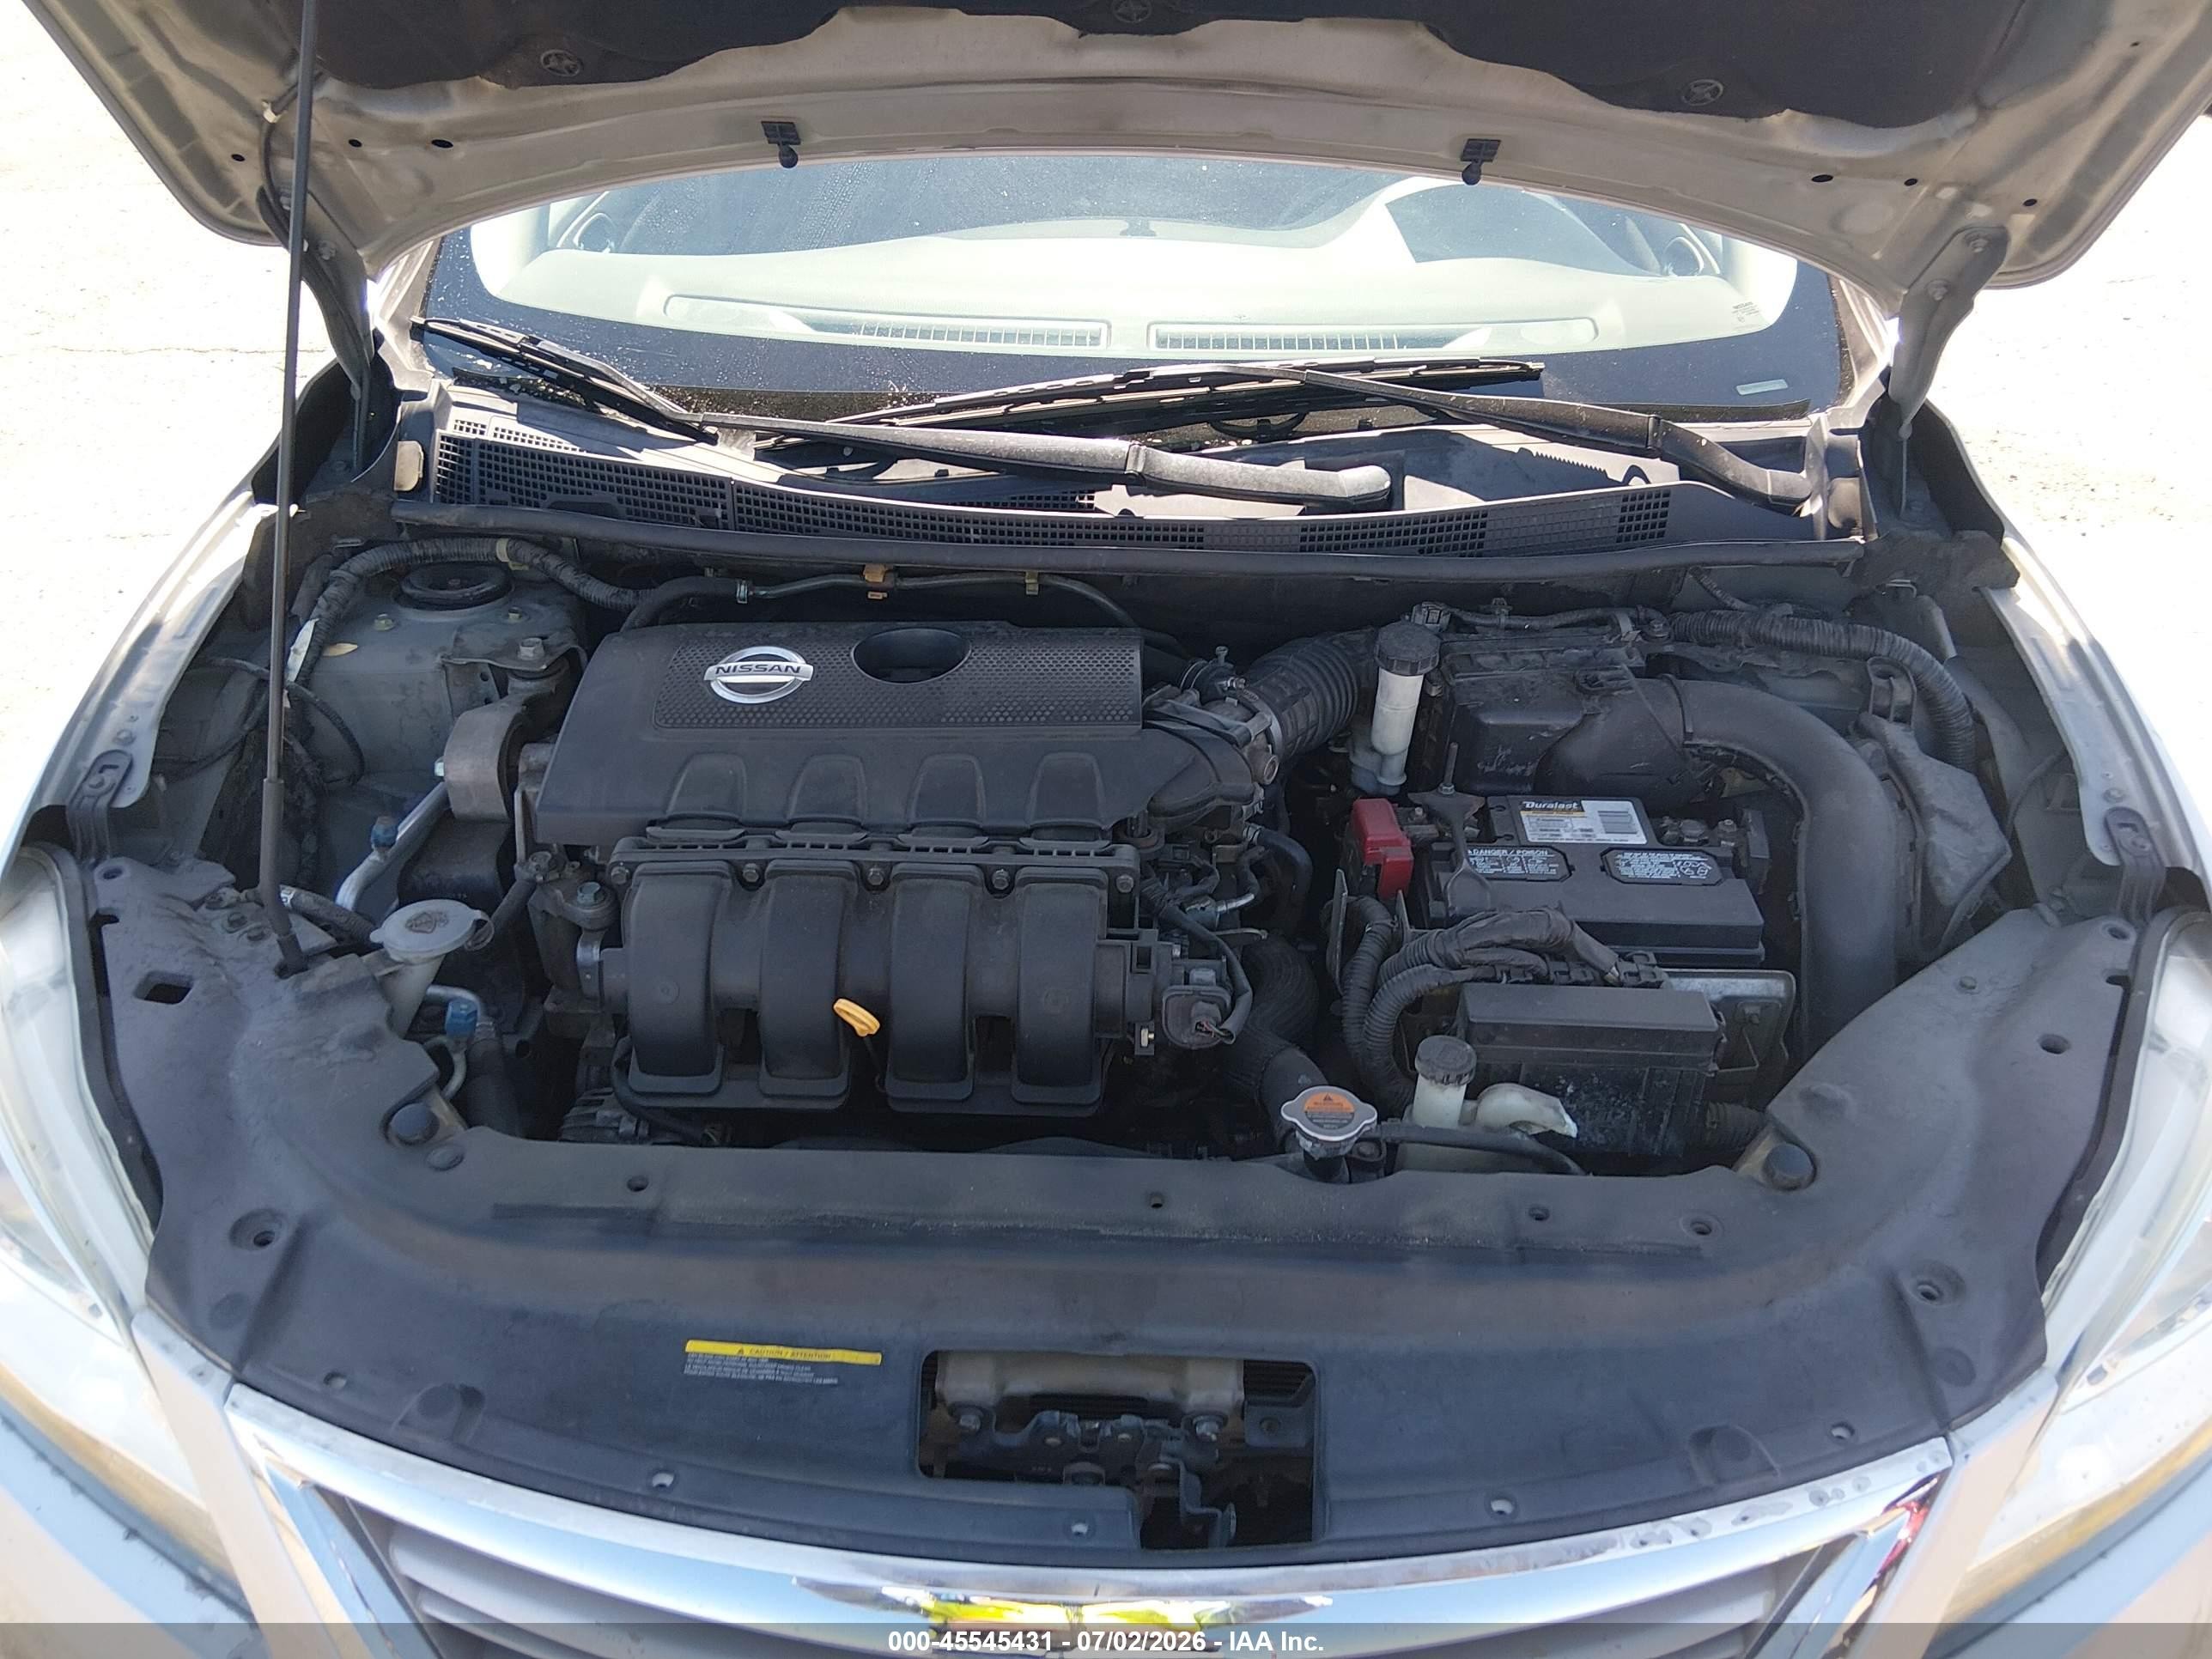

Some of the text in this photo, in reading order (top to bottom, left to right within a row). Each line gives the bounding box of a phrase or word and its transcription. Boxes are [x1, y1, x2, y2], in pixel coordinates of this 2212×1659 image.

[715, 664, 801, 675] NISSAN
[1522, 801, 1578, 811] Duralast
[749, 1346, 783, 1356] CAUTION
